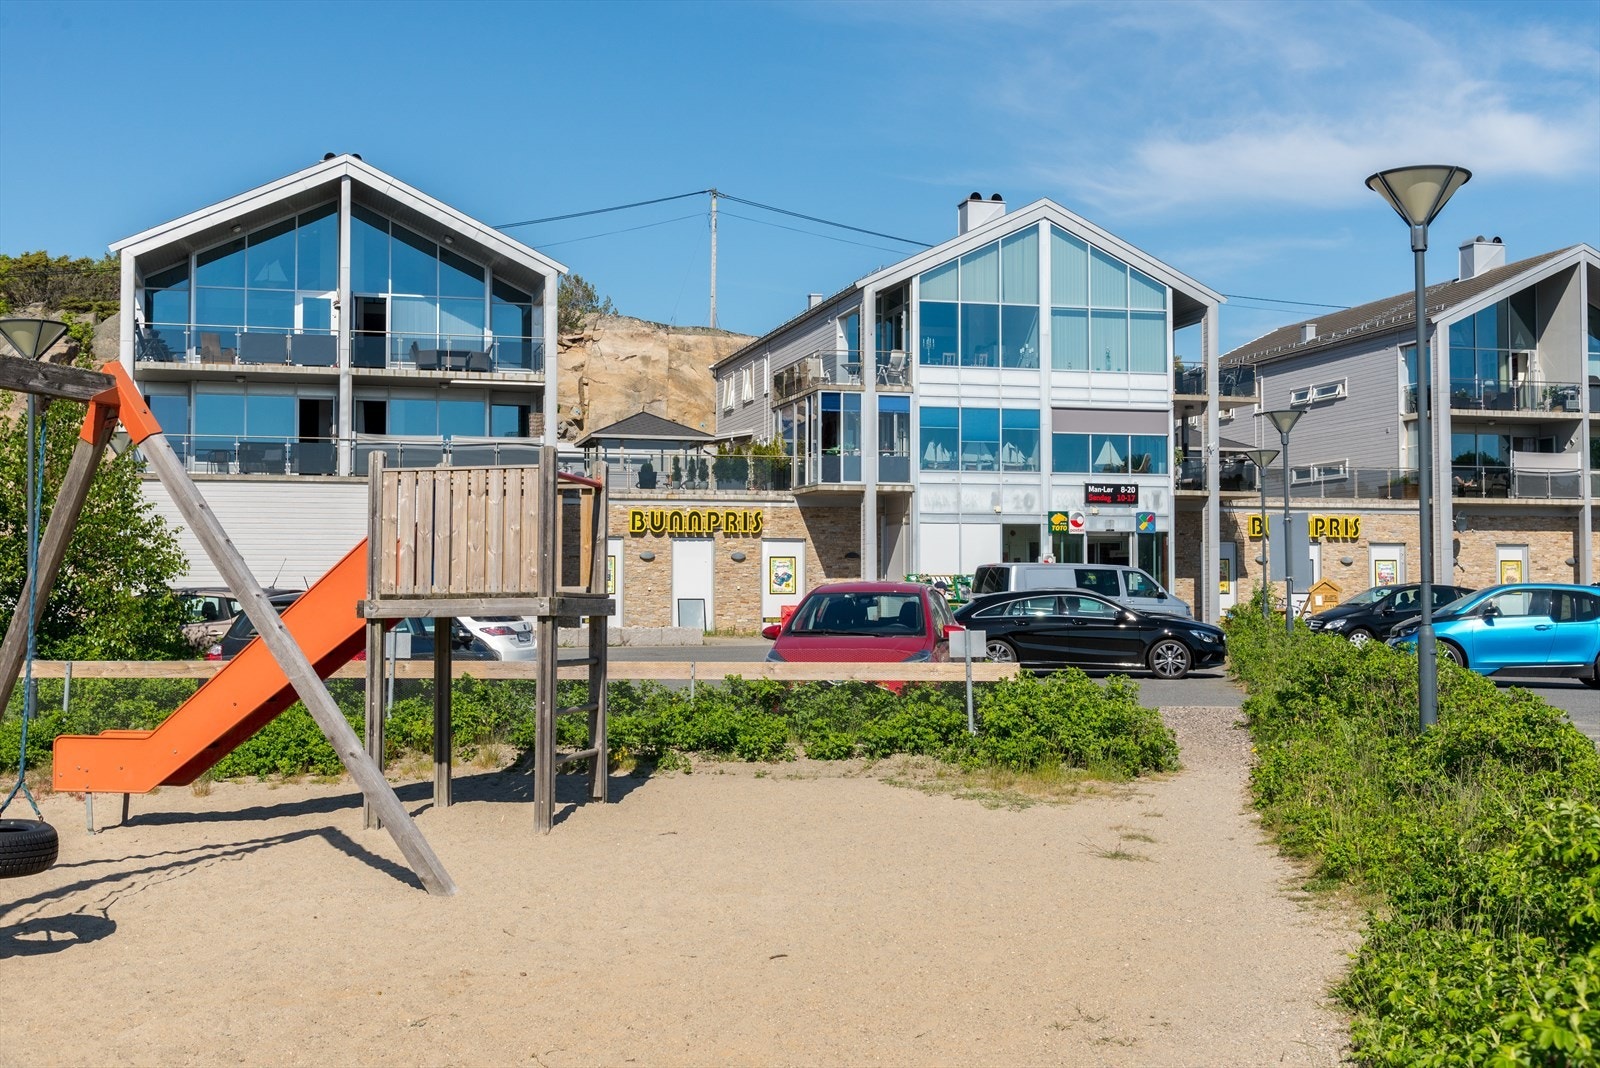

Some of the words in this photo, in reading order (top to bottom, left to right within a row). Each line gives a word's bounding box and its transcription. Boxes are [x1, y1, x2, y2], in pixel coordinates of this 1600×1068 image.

[1120, 486, 1136, 494] 8-20
[1117, 494, 1136, 502] 10-17
[629, 509, 763, 533] BUNNPRIS
